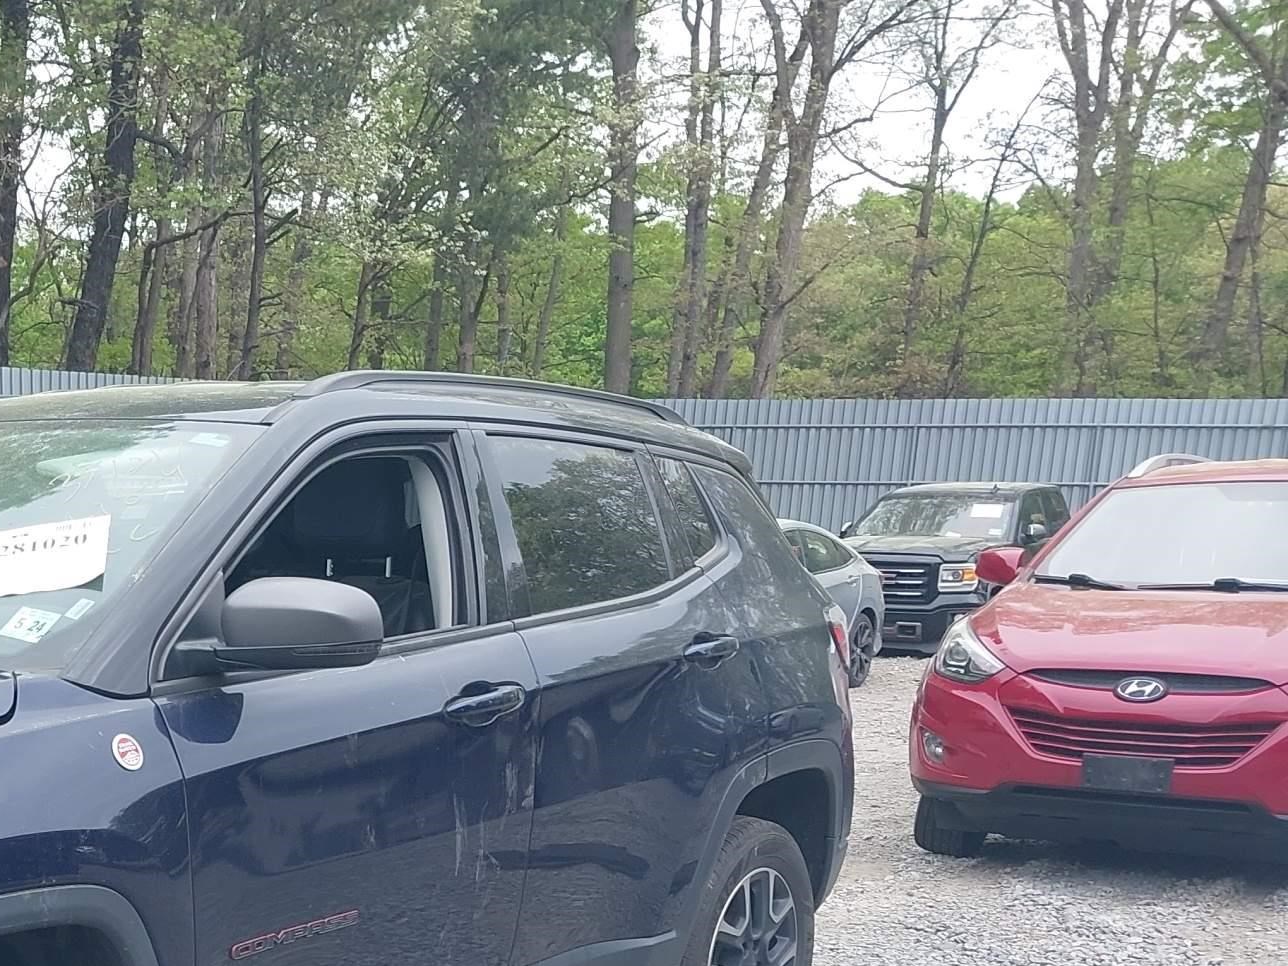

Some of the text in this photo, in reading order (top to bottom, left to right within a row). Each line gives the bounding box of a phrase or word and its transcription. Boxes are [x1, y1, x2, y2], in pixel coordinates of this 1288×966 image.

[14, 617, 48, 634] 5 24
[230, 909, 359, 960] COMPASS
